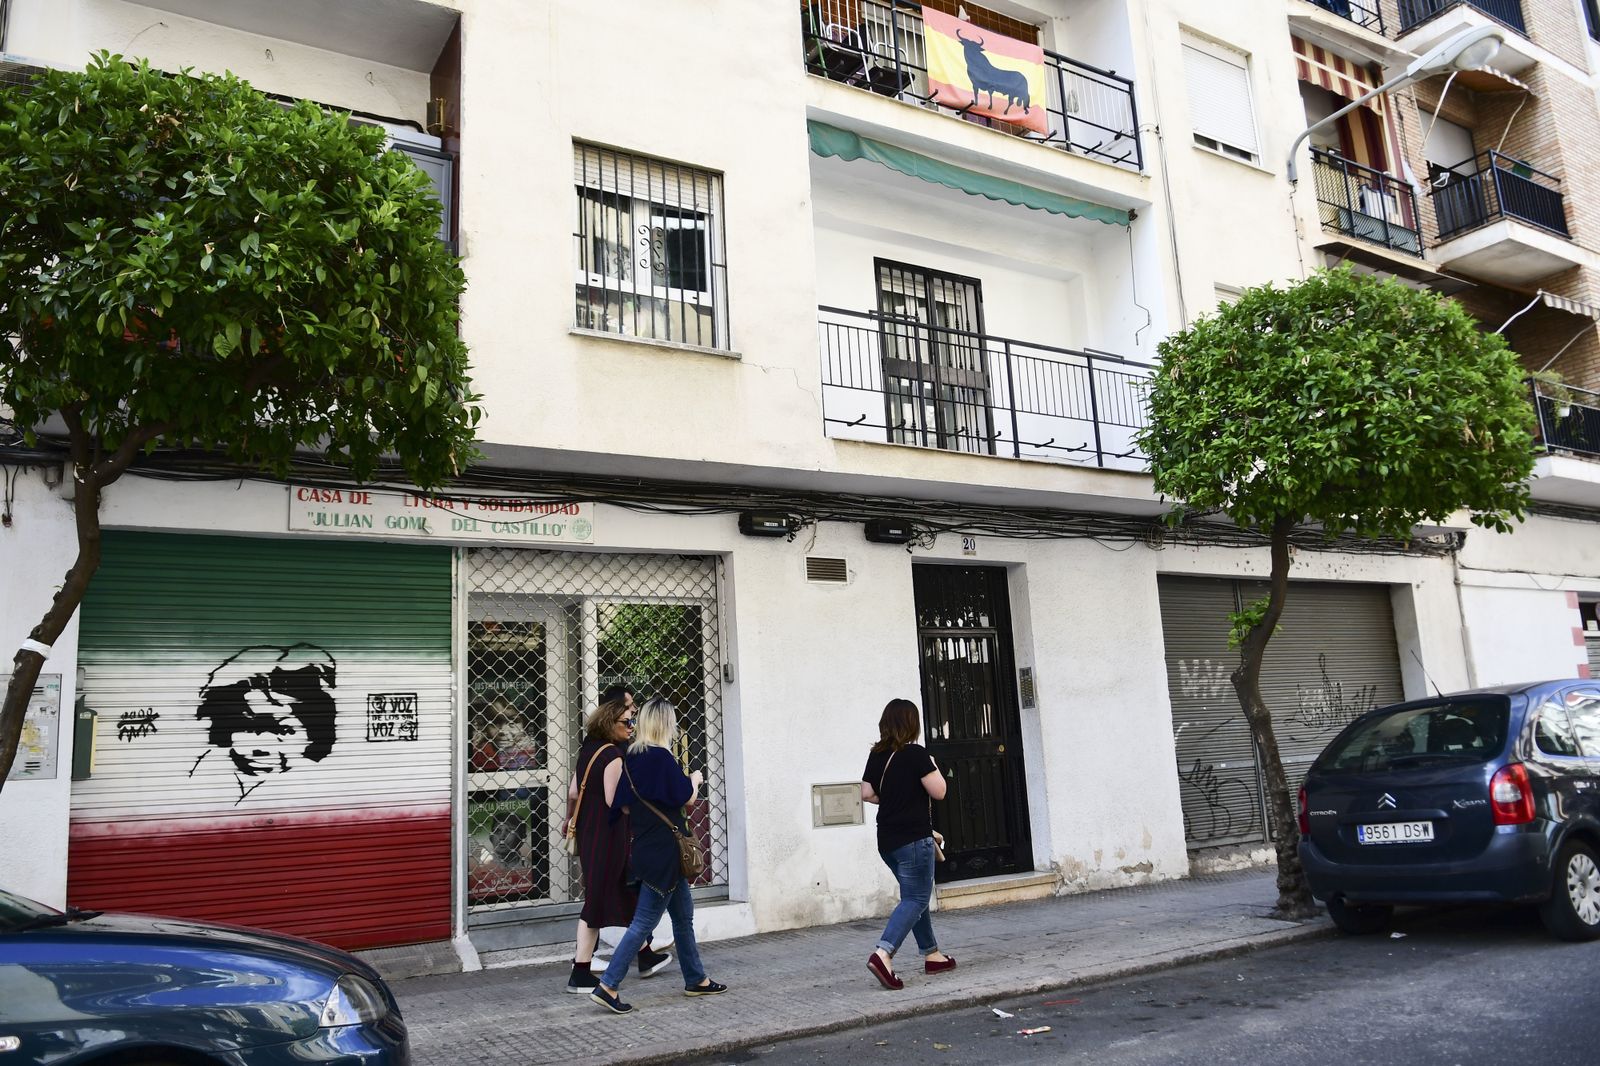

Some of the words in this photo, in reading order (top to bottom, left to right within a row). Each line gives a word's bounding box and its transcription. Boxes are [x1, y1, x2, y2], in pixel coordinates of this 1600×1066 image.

[297, 487, 342, 503] CASA
[349, 491, 373, 506] DE
[463, 498, 472, 511] Y
[478, 498, 580, 517] SOLIDARIDAD
[308, 512, 373, 529] "JULIAN
[452, 518, 481, 533] DEL
[491, 521, 567, 537] CASTILLO"
[963, 537, 976, 551] 20
[388, 697, 412, 714] VOZ
[371, 722, 394, 737] VOZ
[1366, 824, 1398, 840] 9561
[1404, 823, 1430, 839] DSW
